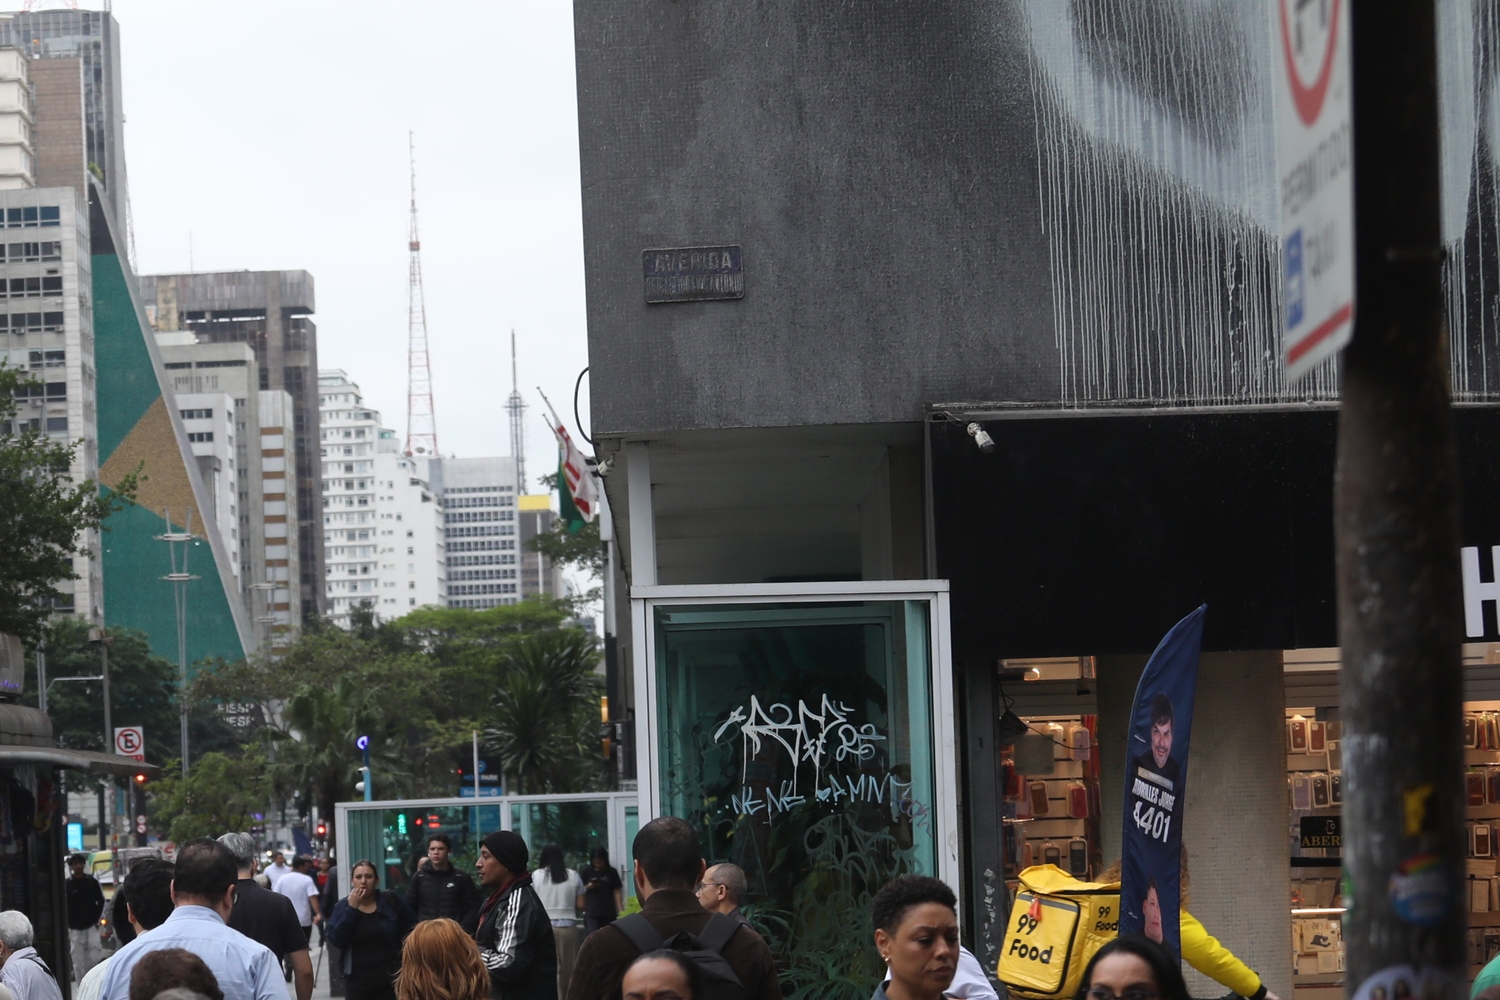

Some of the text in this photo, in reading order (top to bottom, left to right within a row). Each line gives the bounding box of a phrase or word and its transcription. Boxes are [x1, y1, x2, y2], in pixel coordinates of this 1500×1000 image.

[1133, 801, 1171, 843] 4401
[1098, 906, 1111, 919] 99
[1016, 914, 1039, 936] 99
[1008, 938, 1054, 965] Food
